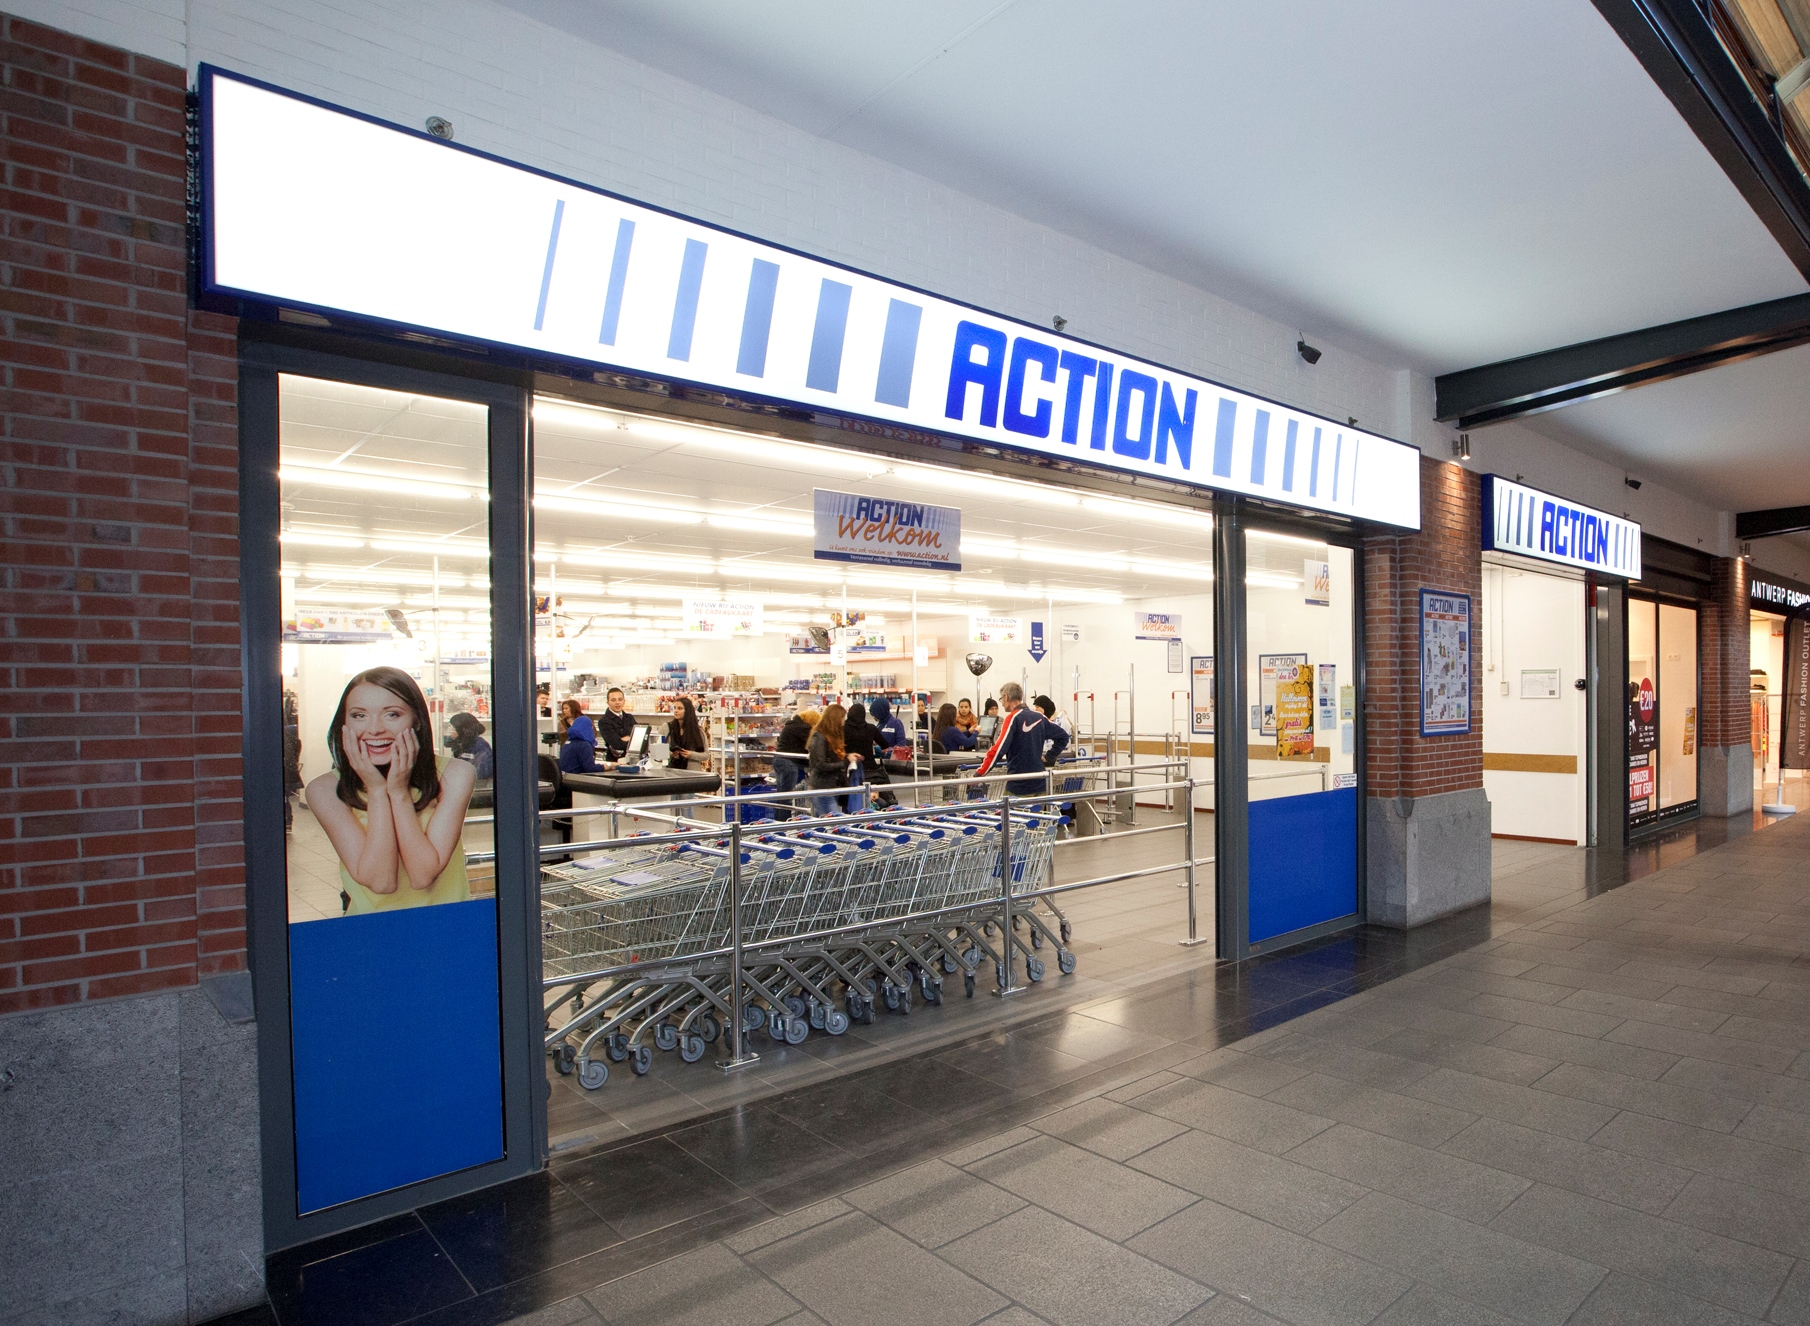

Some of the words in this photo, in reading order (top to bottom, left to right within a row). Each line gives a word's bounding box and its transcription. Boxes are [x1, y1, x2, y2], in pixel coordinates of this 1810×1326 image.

[944, 319, 1199, 471] ACTION
[855, 497, 924, 528] ACTION
[838, 514, 942, 549] Welkom
[1540, 500, 1609, 566] ACTION
[896, 549, 950, 561] www.action.nl
[1751, 579, 1786, 604] ANTWERP
[1787, 589, 1810, 607] FASHI
[1429, 597, 1454, 613] ACTION
[1147, 613, 1170, 624] ACTION
[1141, 621, 1176, 633] Welkom
[418, 639, 427, 651] 3
[563, 643, 571, 654] 4
[837, 649, 844, 659] 5
[1200, 660, 1214, 669] ACT
[1800, 662, 1808, 707] FASHION
[1640, 690, 1653, 711] €20
[1265, 713, 1276, 725] 24
[1799, 709, 1807, 756] ANTWERP
[1630, 769, 1649, 785] LPRIJZEN
[1633, 783, 1642, 797] TOT
